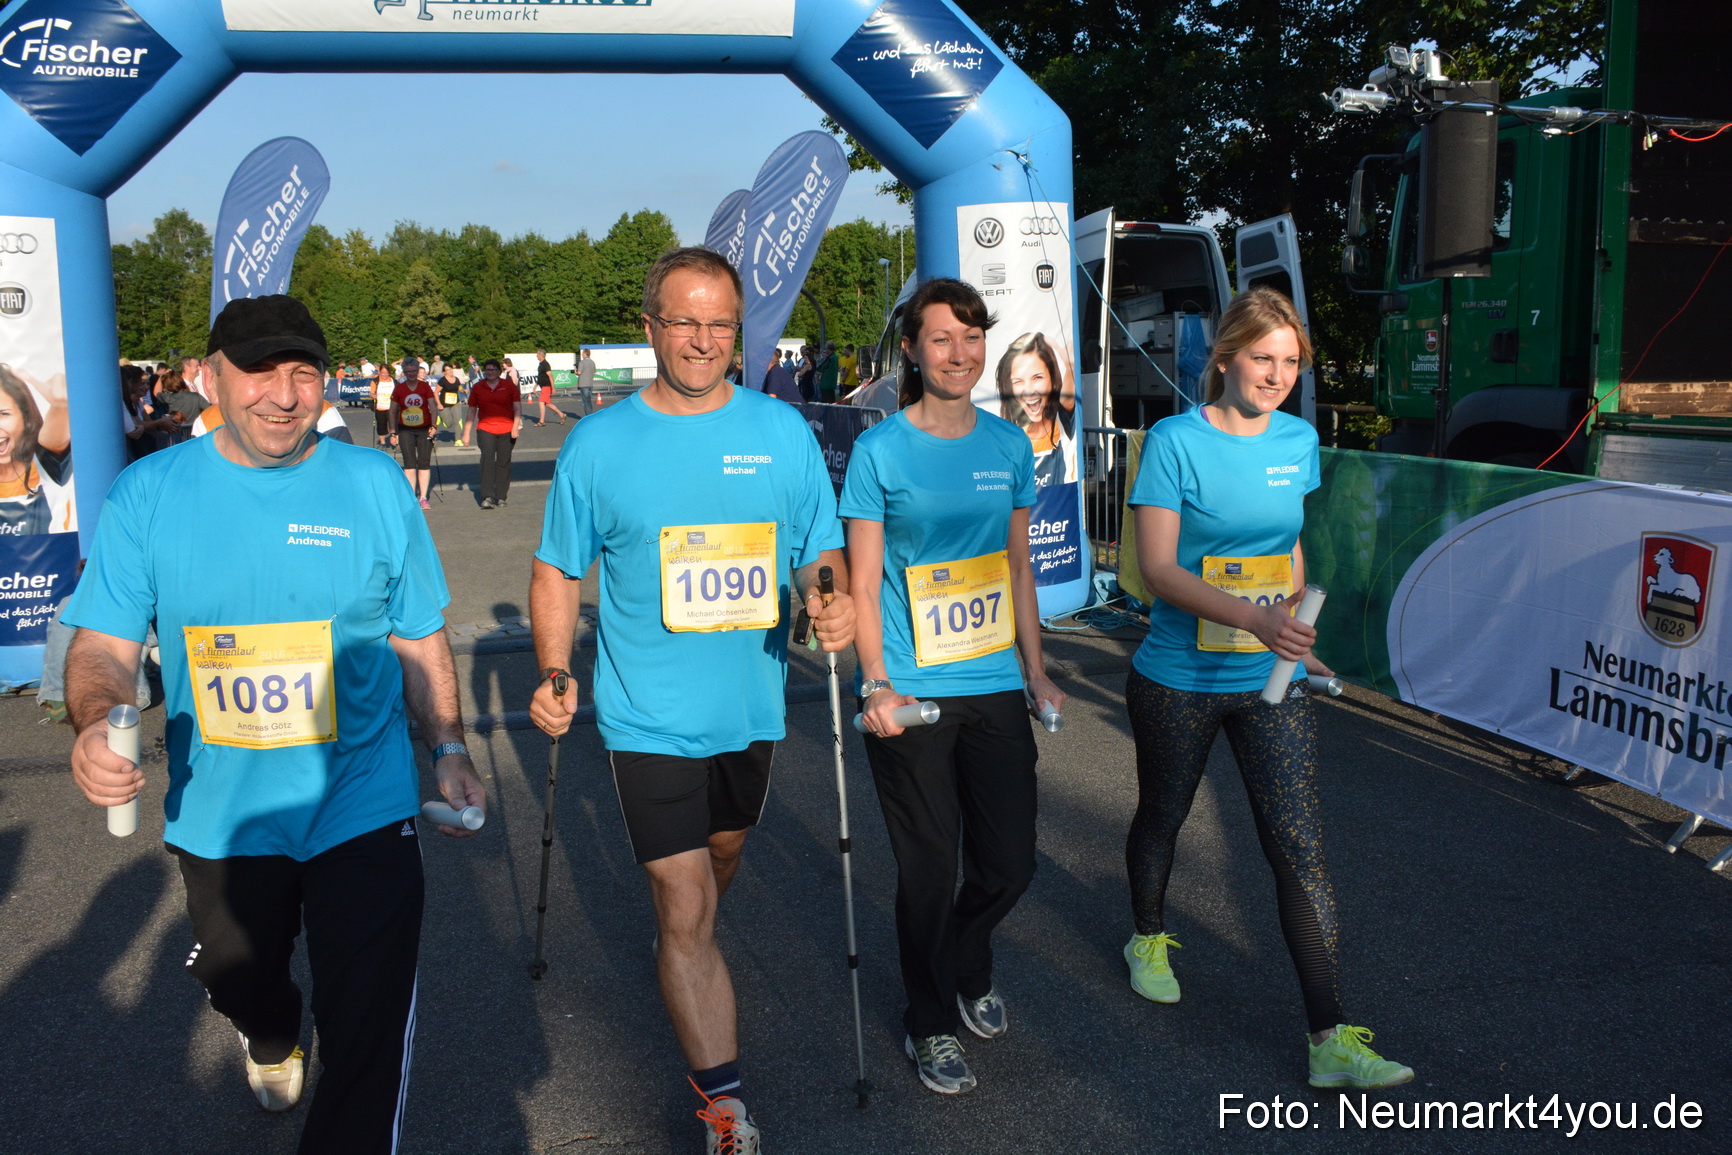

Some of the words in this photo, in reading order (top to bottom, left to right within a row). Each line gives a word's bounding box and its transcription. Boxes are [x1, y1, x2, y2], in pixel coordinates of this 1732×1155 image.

[452, 7, 539, 21] neumarkt
[21, 39, 148, 65] Fischer
[873, 43, 902, 60] und
[934, 40, 984, 55] Lächeln
[953, 58, 982, 70] mit!
[32, 65, 140, 78] AUTOMOBILE
[766, 155, 823, 276] Fischer
[237, 164, 302, 288] Fischer
[786, 175, 831, 274] AUTOMOBILE
[257, 186, 310, 286] AUTOMOBILE
[726, 208, 746, 265] cher
[1038, 269, 1054, 283] FIAT
[0, 292, 24, 309] FIAT
[1477, 300, 1507, 308] 26.340
[1531, 309, 1540, 326] 7
[406, 397, 420, 406] 48
[823, 443, 846, 469] cher
[723, 467, 756, 475] Michael
[1268, 479, 1290, 487] Kerstin
[299, 524, 351, 538] PFLEIDERER
[1028, 519, 1069, 536] cher
[287, 536, 332, 547] Andreas
[680, 542, 722, 552] firmenlauf
[1037, 550, 1052, 560] das
[1053, 545, 1077, 558] Lächeln
[668, 556, 702, 565] walken
[1040, 561, 1060, 573] fährt
[1062, 554, 1076, 564] mit!
[0, 572, 59, 590] cher
[926, 576, 966, 589] firmenlauf
[1217, 572, 1255, 580] firmenlauf
[676, 565, 767, 603] 1090
[0, 590, 51, 600] OMOBILE
[916, 591, 949, 602] walken
[12, 606, 31, 616] das
[716, 608, 758, 617] Ochsenkühn
[925, 591, 1002, 636] 1097
[16, 617, 45, 631] fährt
[1653, 616, 1687, 638] 1628
[207, 646, 257, 656] firmenlauf
[936, 640, 971, 650] Alexandra
[196, 660, 233, 670] walken
[1583, 640, 1732, 715] Neumarkt
[207, 672, 314, 714] 1081
[1549, 667, 1732, 771] Lammsbr
[237, 722, 269, 732] Andreas
[271, 722, 292, 731] Götz
